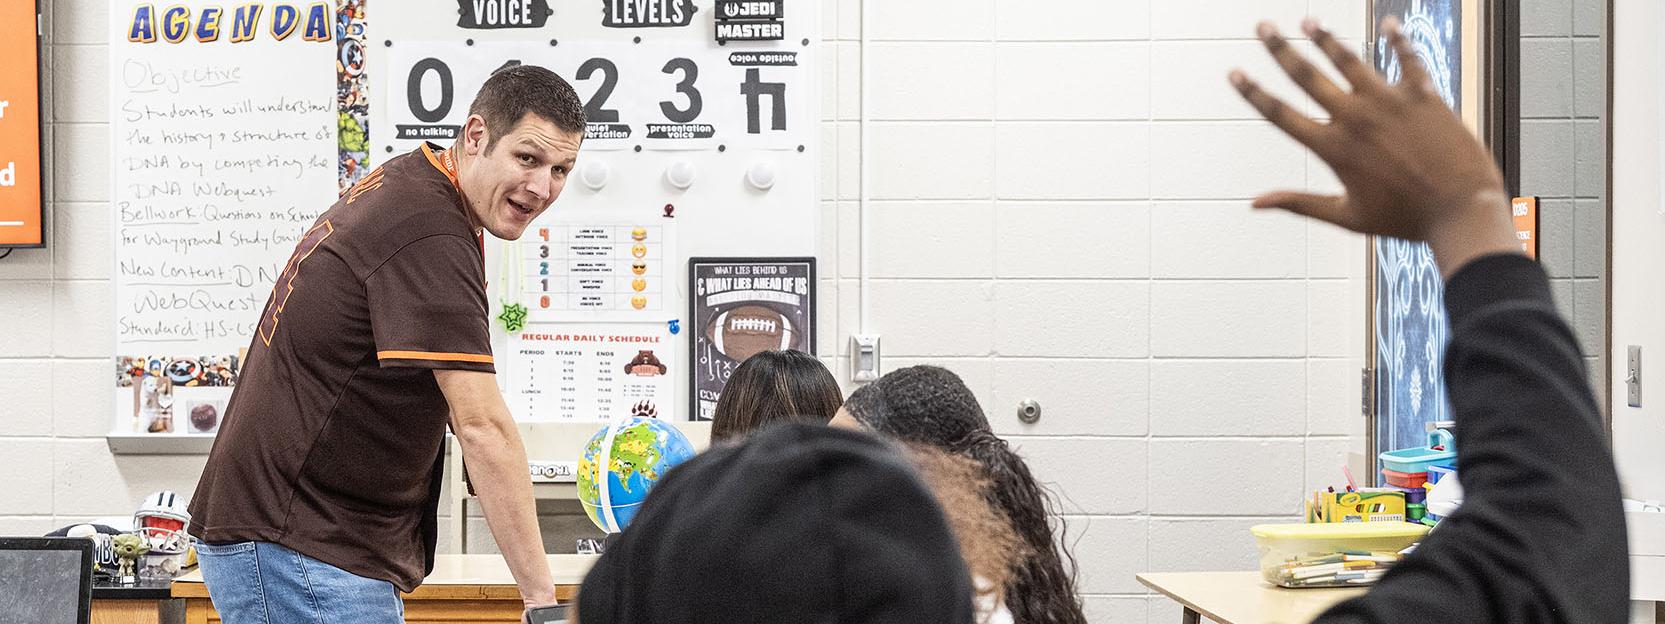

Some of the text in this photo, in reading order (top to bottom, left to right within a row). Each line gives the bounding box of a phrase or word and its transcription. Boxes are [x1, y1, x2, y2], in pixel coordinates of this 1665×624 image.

[473, 0, 684, 25] VOICE LEVELS
[739, 2, 776, 16] JEDI
[128, 2, 331, 43] AGENDA
[717, 24, 782, 38] MASTER
[730, 54, 794, 63] outside voice
[122, 58, 241, 94] Objective
[406, 57, 454, 123] 0
[575, 57, 620, 122] 2
[659, 57, 703, 123] 3
[122, 99, 213, 122] Students
[223, 98, 252, 114] will
[741, 68, 787, 134] 4
[424, 127, 454, 137] talking
[650, 124, 711, 134] presentation
[127, 129, 152, 145] the
[161, 130, 212, 150] history
[233, 129, 309, 143] structure
[123, 156, 169, 171] DNA
[180, 155, 202, 176] by
[310, 154, 328, 169] the
[130, 182, 181, 199] DNA
[204, 205, 262, 221] Questions
[270, 211, 284, 220] on
[230, 231, 268, 250] Study
[272, 227, 304, 244] Guid
[540, 245, 549, 258] 3
[121, 258, 154, 277] New
[235, 263, 278, 288] DN
[540, 262, 549, 275] 2
[713, 266, 788, 275] WHAT LIES BEHIND US
[541, 279, 548, 291] 1
[705, 278, 732, 294] WHAT
[733, 278, 752, 290] LIES
[752, 278, 782, 291] AHEAD
[782, 278, 794, 292] OF
[795, 277, 807, 296] US
[522, 333, 660, 343] REGULAR DAILY SCHEDULE
